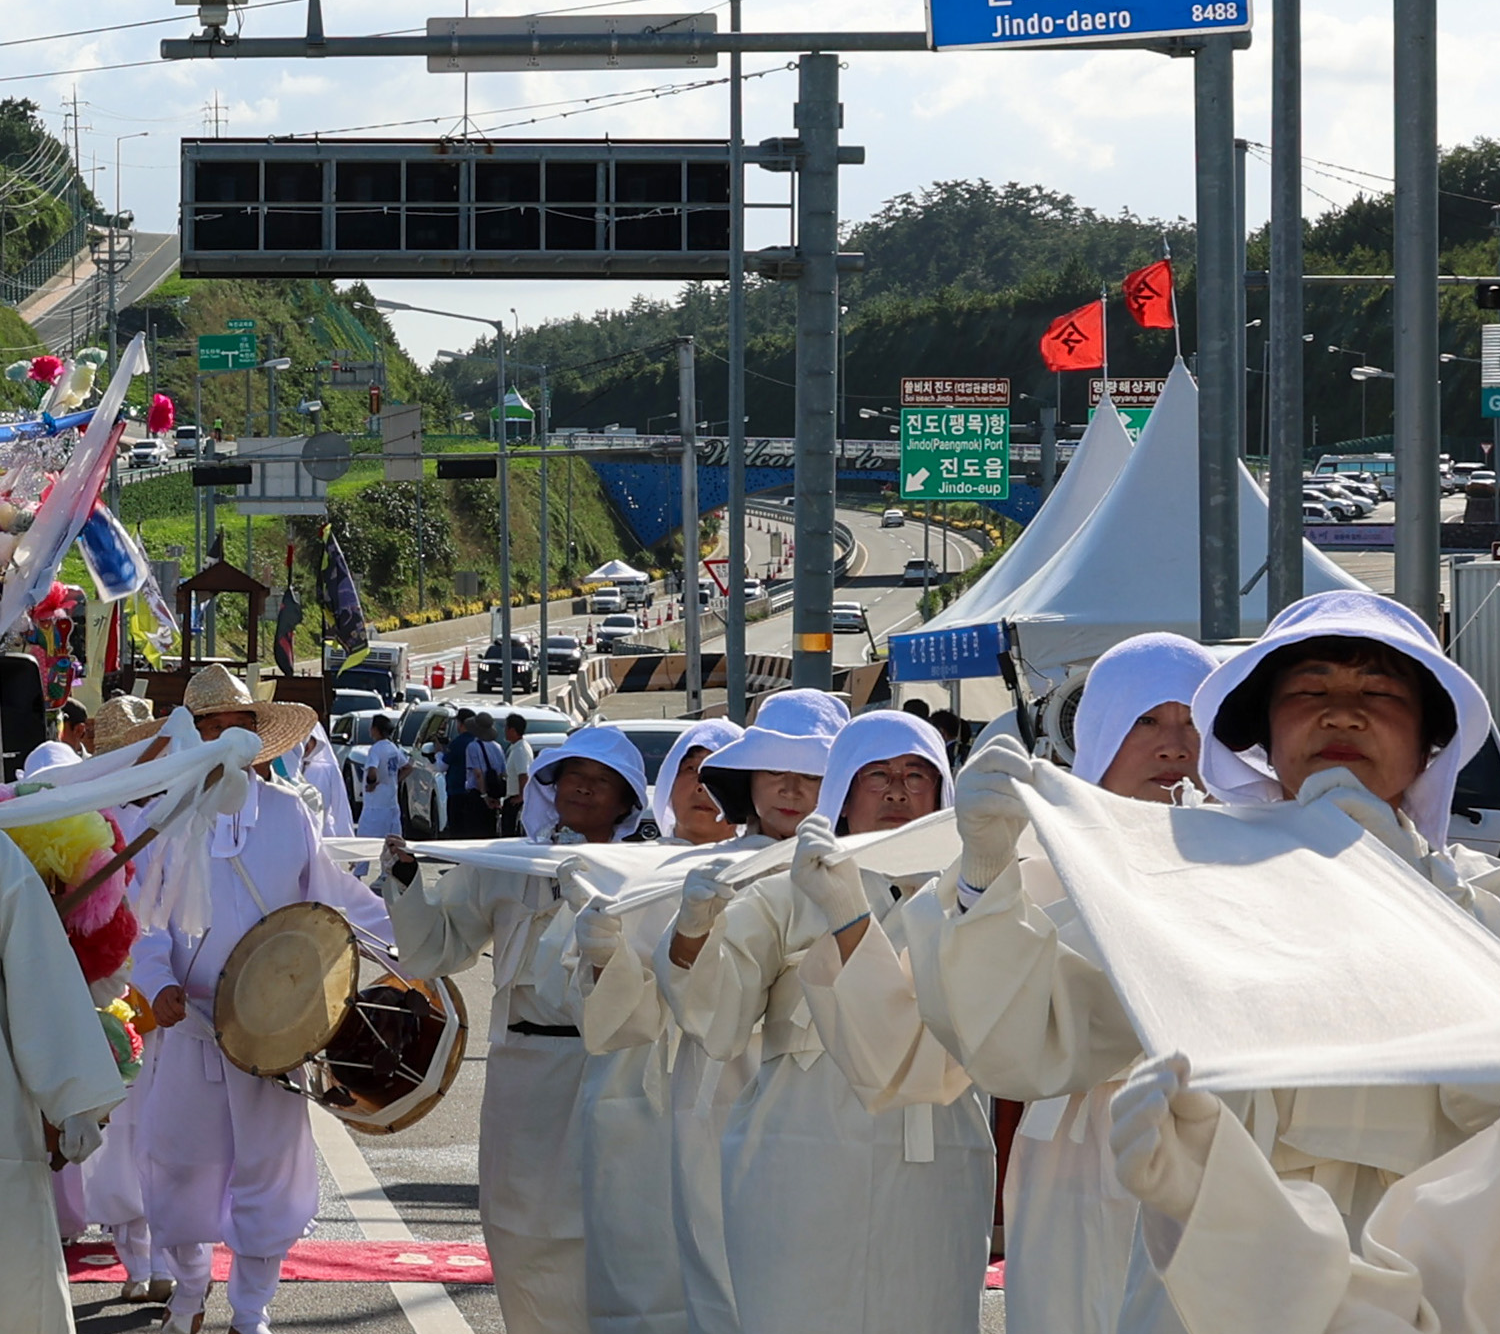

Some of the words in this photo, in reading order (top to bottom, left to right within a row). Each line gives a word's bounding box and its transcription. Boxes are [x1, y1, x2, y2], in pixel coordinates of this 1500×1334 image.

[991, 9, 1132, 38] Jindo-daero
[1192, 2, 1238, 22] 8488
[934, 381, 953, 393] 진도
[906, 413, 1006, 436] 진도(팽목)항
[984, 437, 1003, 450] Port
[855, 448, 885, 469] to
[939, 456, 1004, 479] 진도읍
[938, 481, 1002, 496] Jindo-eup
